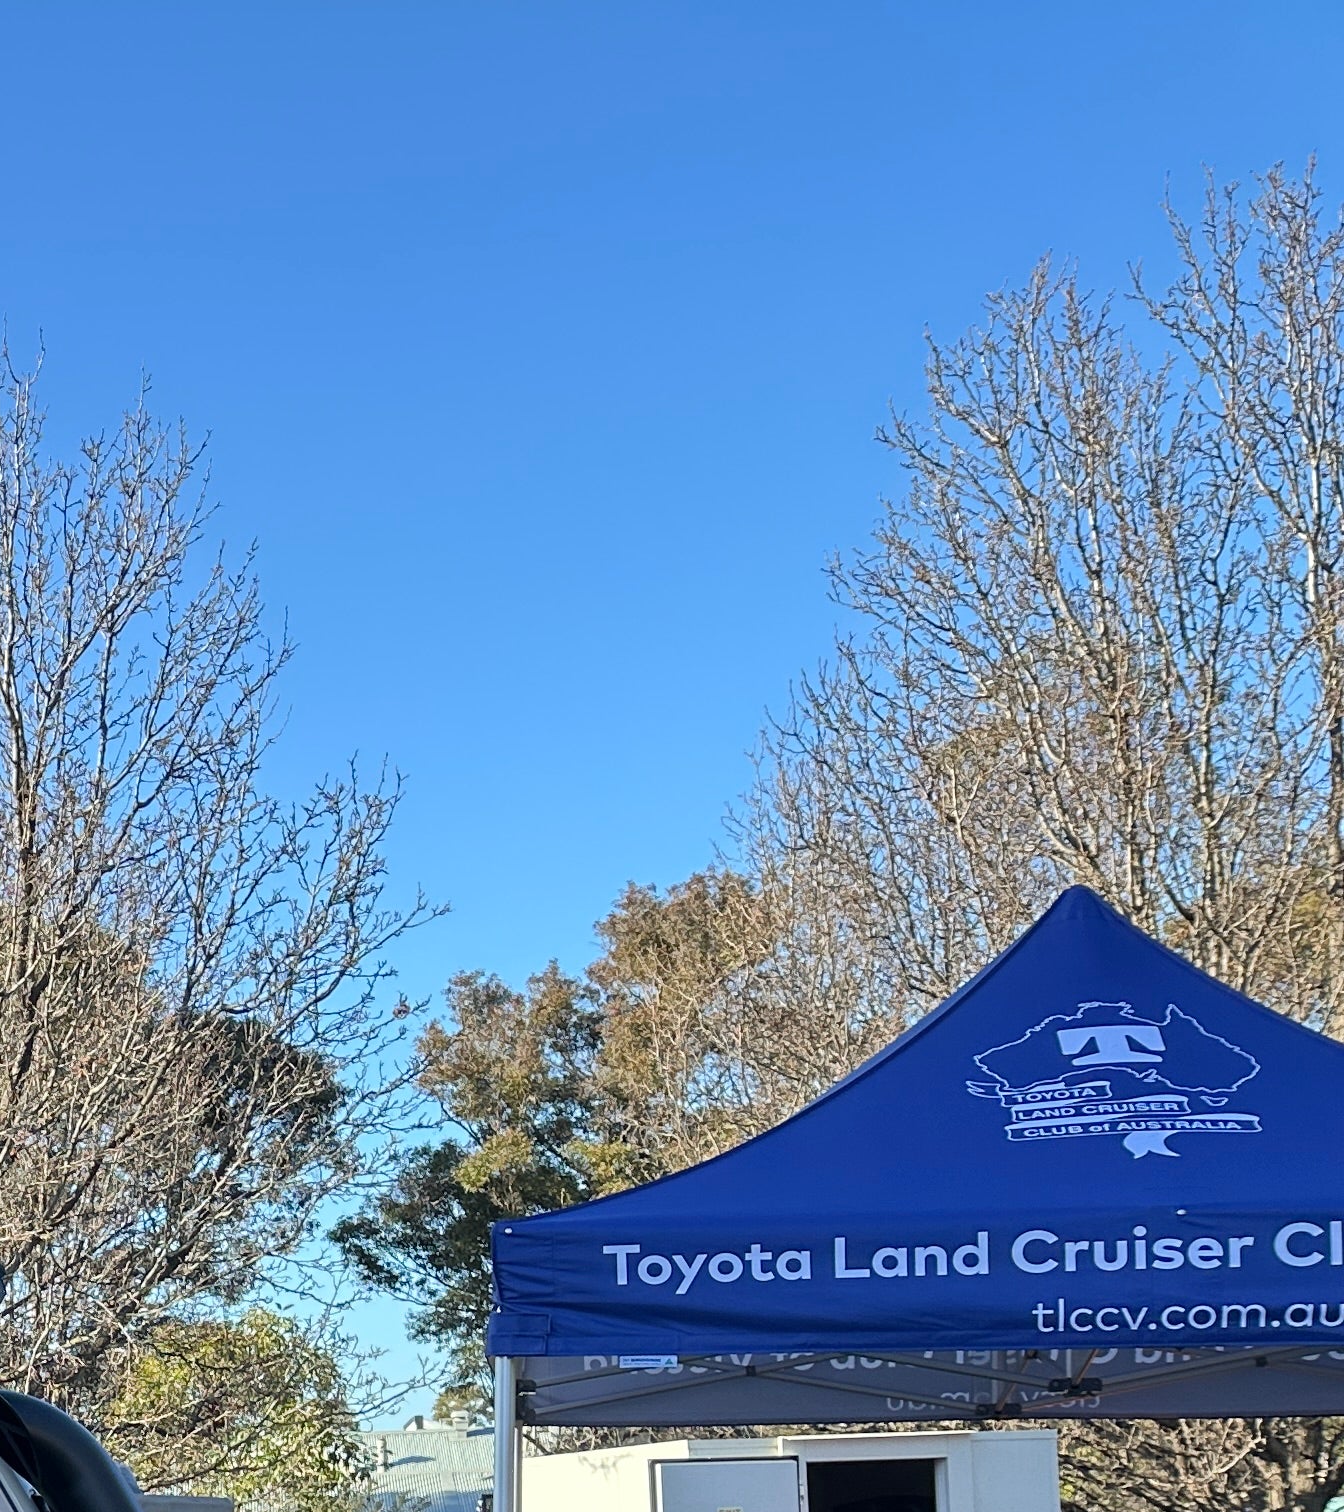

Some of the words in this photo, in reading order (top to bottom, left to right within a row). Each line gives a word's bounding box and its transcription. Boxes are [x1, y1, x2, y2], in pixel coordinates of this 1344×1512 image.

[1014, 1086, 1098, 1104] TOYOTA
[1016, 1106, 1070, 1121] LAND
[1081, 1101, 1180, 1115] CRUISER
[1023, 1124, 1085, 1138] CLUB
[1089, 1122, 1112, 1134] of
[1116, 1119, 1243, 1132] AUSTRALIA
[602, 1242, 812, 1295] Toyota
[834, 1231, 990, 1280] Land
[1011, 1225, 1255, 1275] Cruiser
[1031, 1298, 1344, 1333] tlccv.com.au
